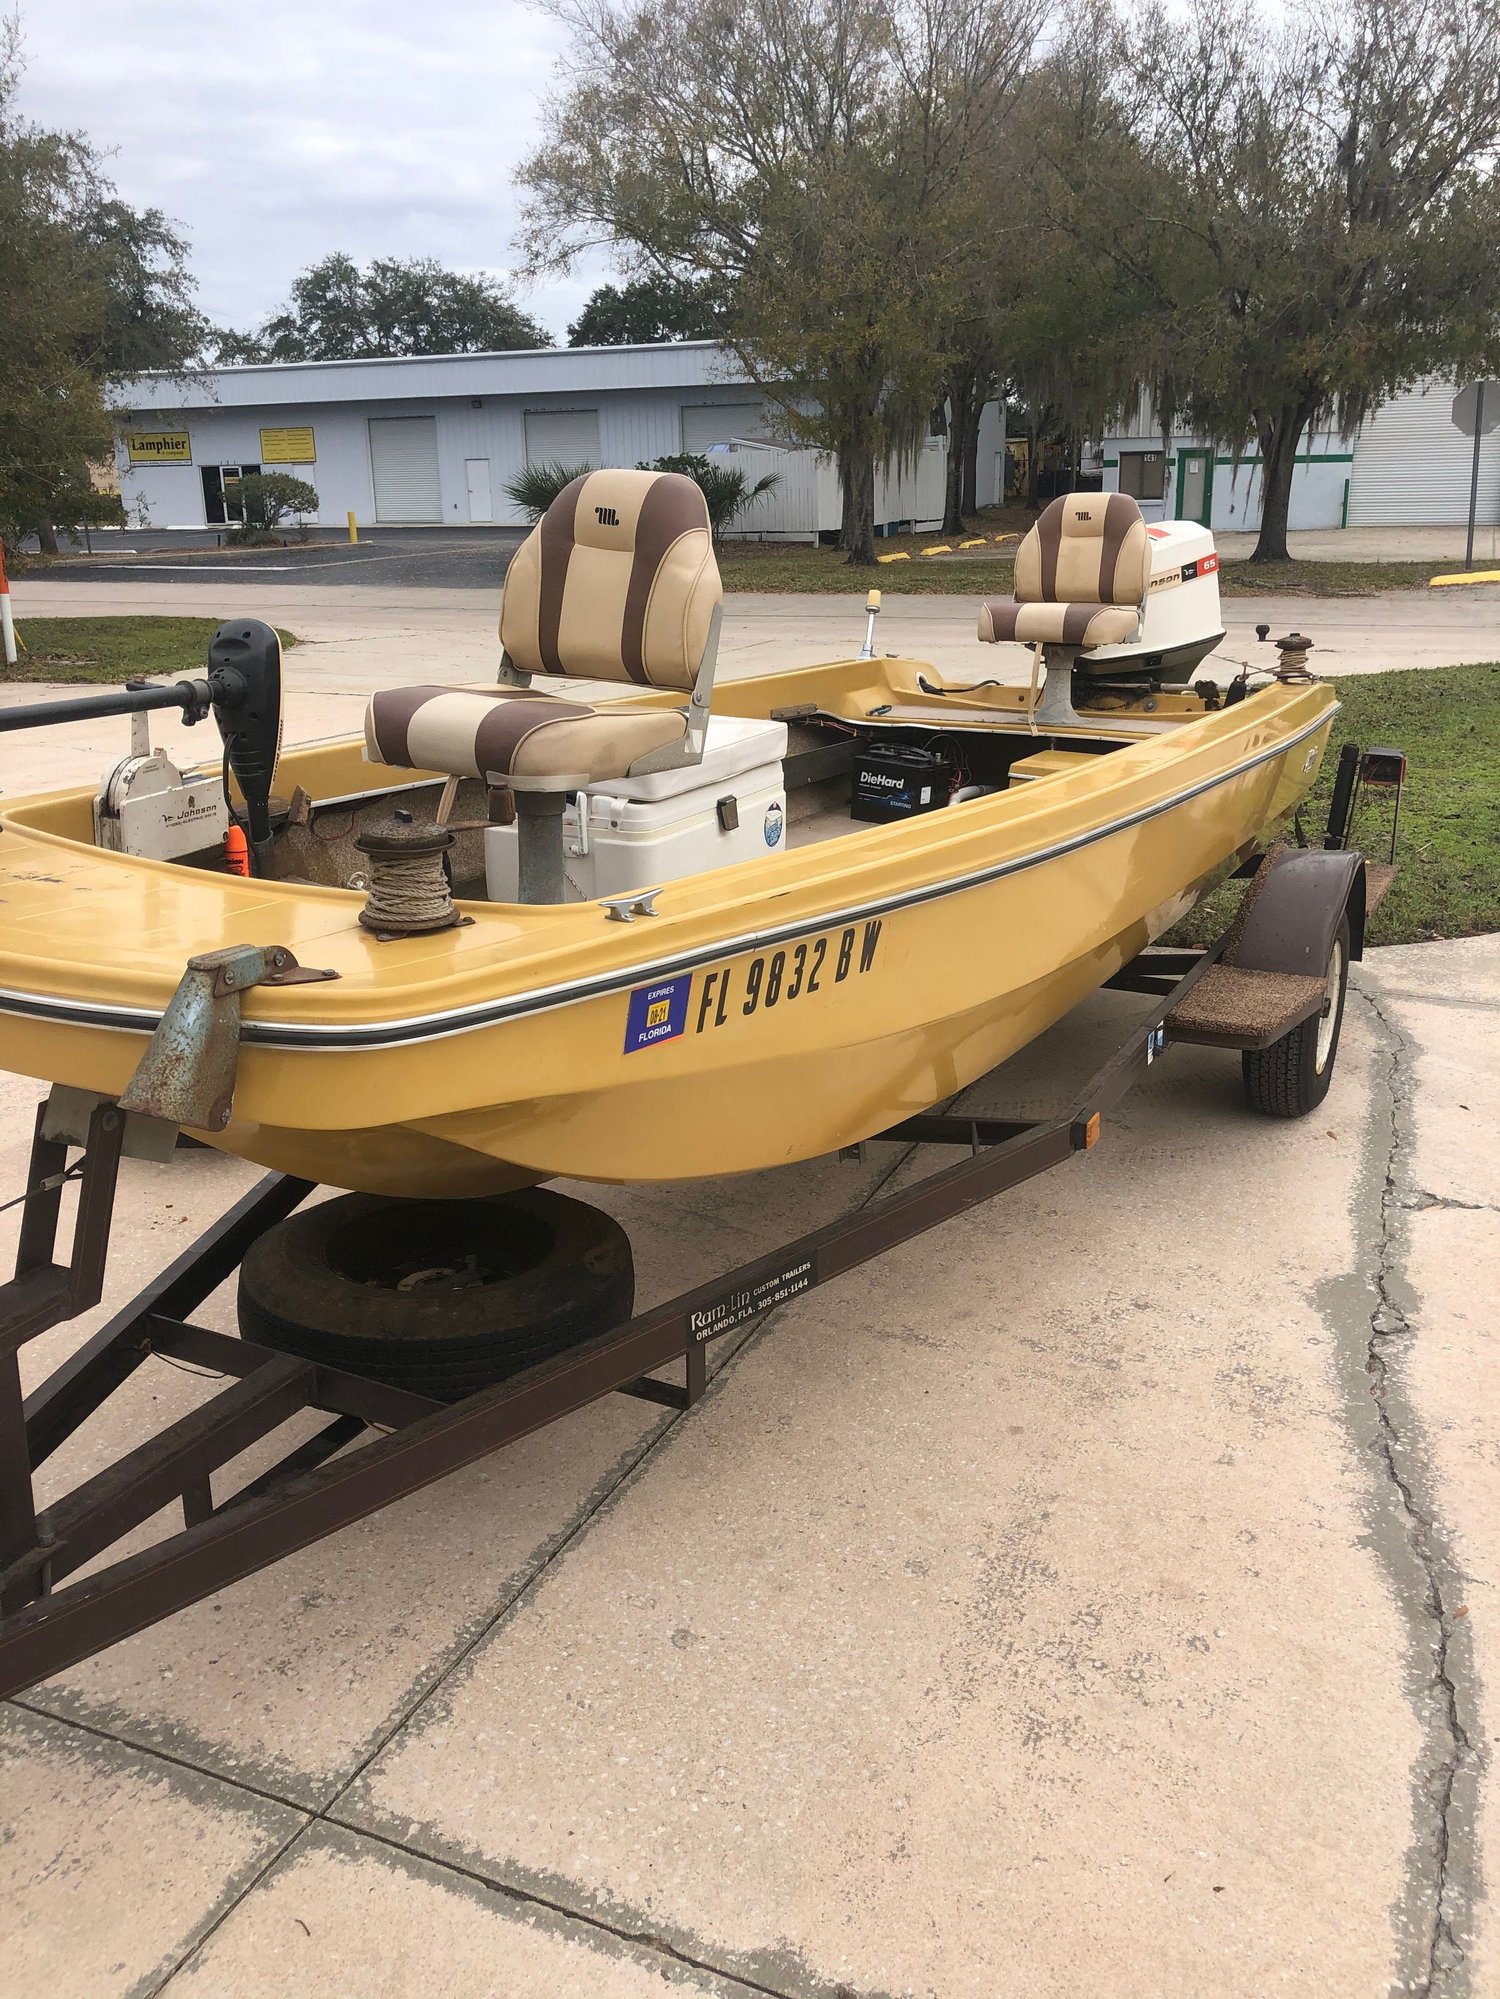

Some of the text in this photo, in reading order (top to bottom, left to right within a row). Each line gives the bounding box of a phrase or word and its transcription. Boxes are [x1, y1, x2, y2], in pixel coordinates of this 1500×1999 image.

[132, 437, 186, 455] Lamphier
[1203, 558, 1216, 571] 65
[1149, 573, 1180, 588] nson
[860, 771, 905, 789] DieHard
[177, 804, 217, 820] Johnson
[889, 800, 912, 809] STARTING
[647, 986, 675, 1000] EXPIRES
[696, 968, 731, 1033] FL
[743, 938, 827, 1015] 9832
[638, 1024, 672, 1043] FLORIDA
[753, 1278, 779, 1296] CUSTOM
[781, 1261, 811, 1281] TRAILERS
[696, 1277, 809, 1341] ORLANDO, FLA. 305-851-1144
